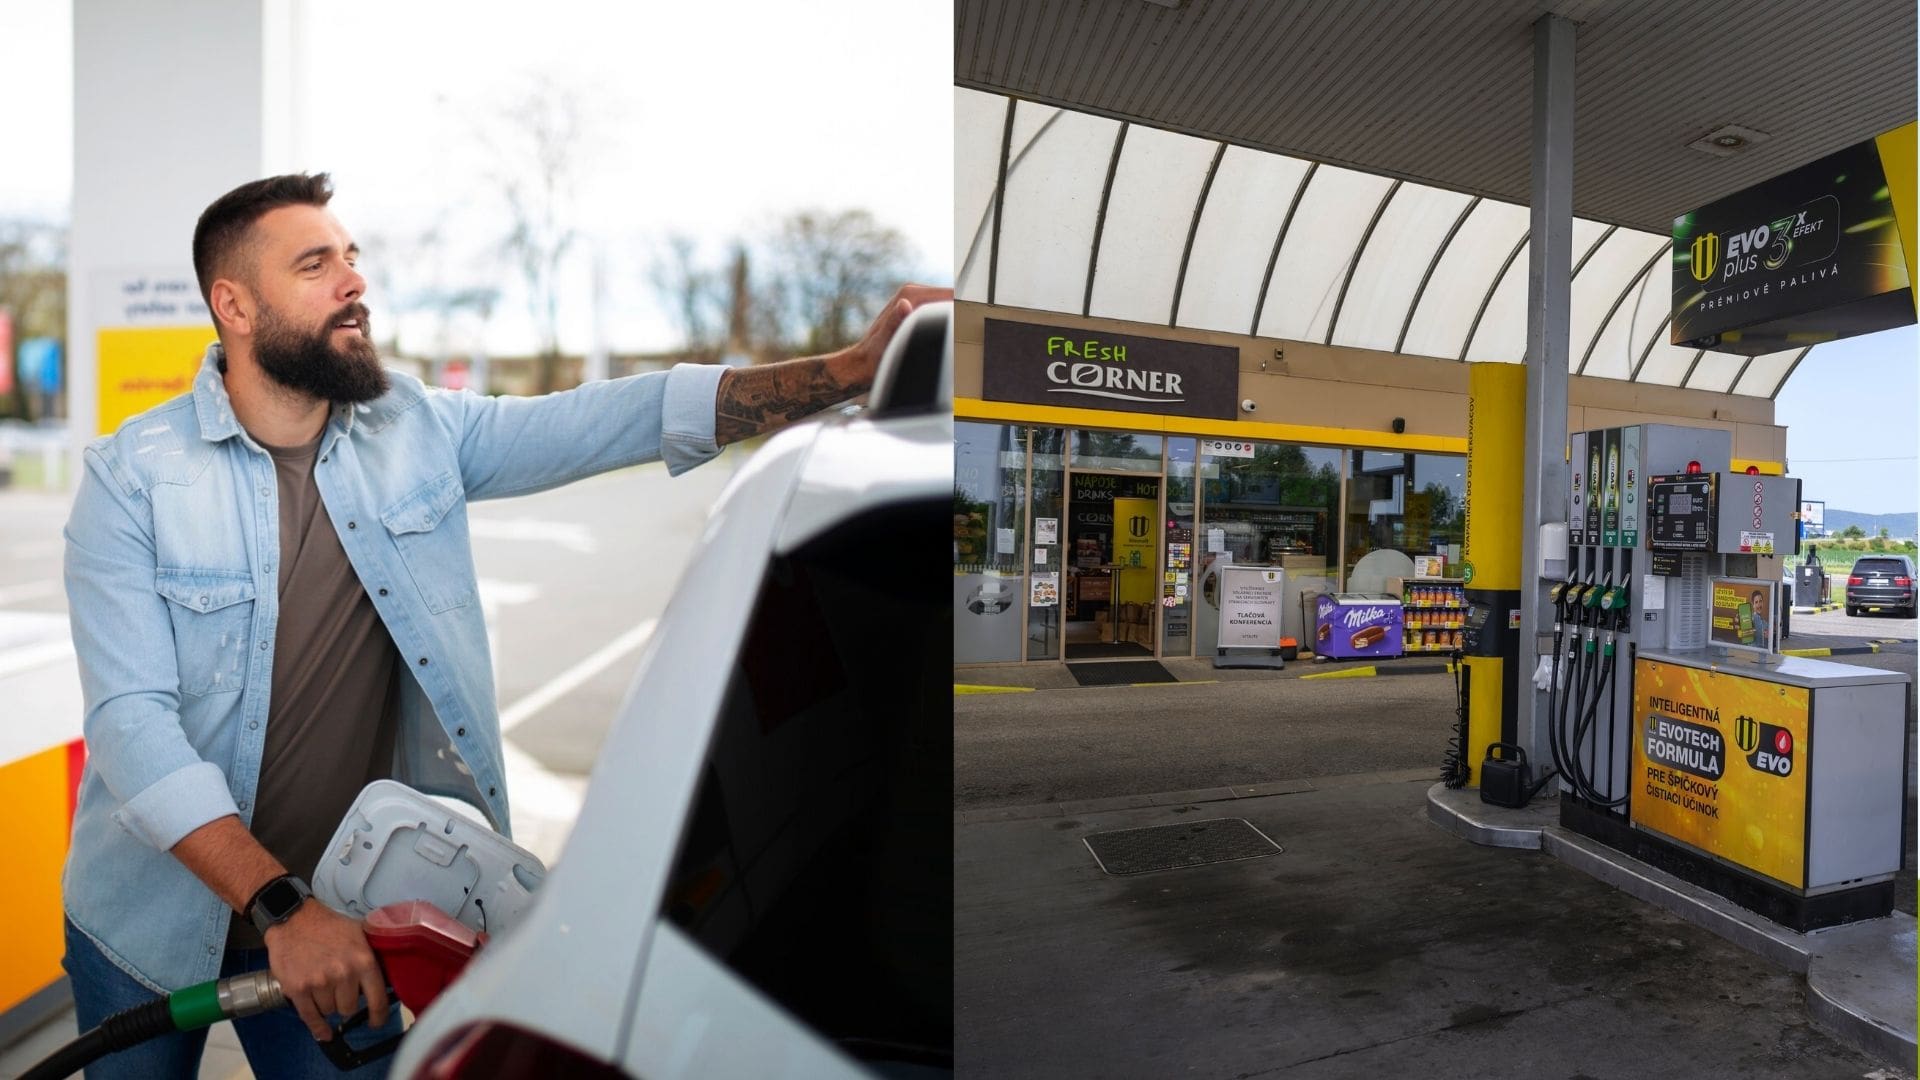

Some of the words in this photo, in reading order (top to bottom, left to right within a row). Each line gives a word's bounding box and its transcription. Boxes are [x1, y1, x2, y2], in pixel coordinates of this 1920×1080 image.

[1727, 225, 1770, 259] EVO
[1793, 218, 1824, 238] EFEKT
[1723, 253, 1758, 283] plus
[1700, 282, 1770, 312] PRÉMIOVÉ
[1780, 264, 1839, 290] PALIVÁ
[1047, 336, 1128, 362] FRESH
[1046, 362, 1184, 395] CORNER
[1078, 488, 1114, 500] DRINKS
[1136, 483, 1158, 496] HOT
[1344, 606, 1386, 628] Milka
[1649, 696, 1721, 724] INTELIGENTNÁ
[1659, 721, 1720, 752] EVOTECH
[1648, 738, 1720, 775] FORMULA
[1756, 751, 1791, 774] EVO
[1646, 782, 1681, 807] ČISTIACI
[1647, 766, 1666, 784] PRE
[1668, 770, 1719, 801] ŠPIČKOVÝ
